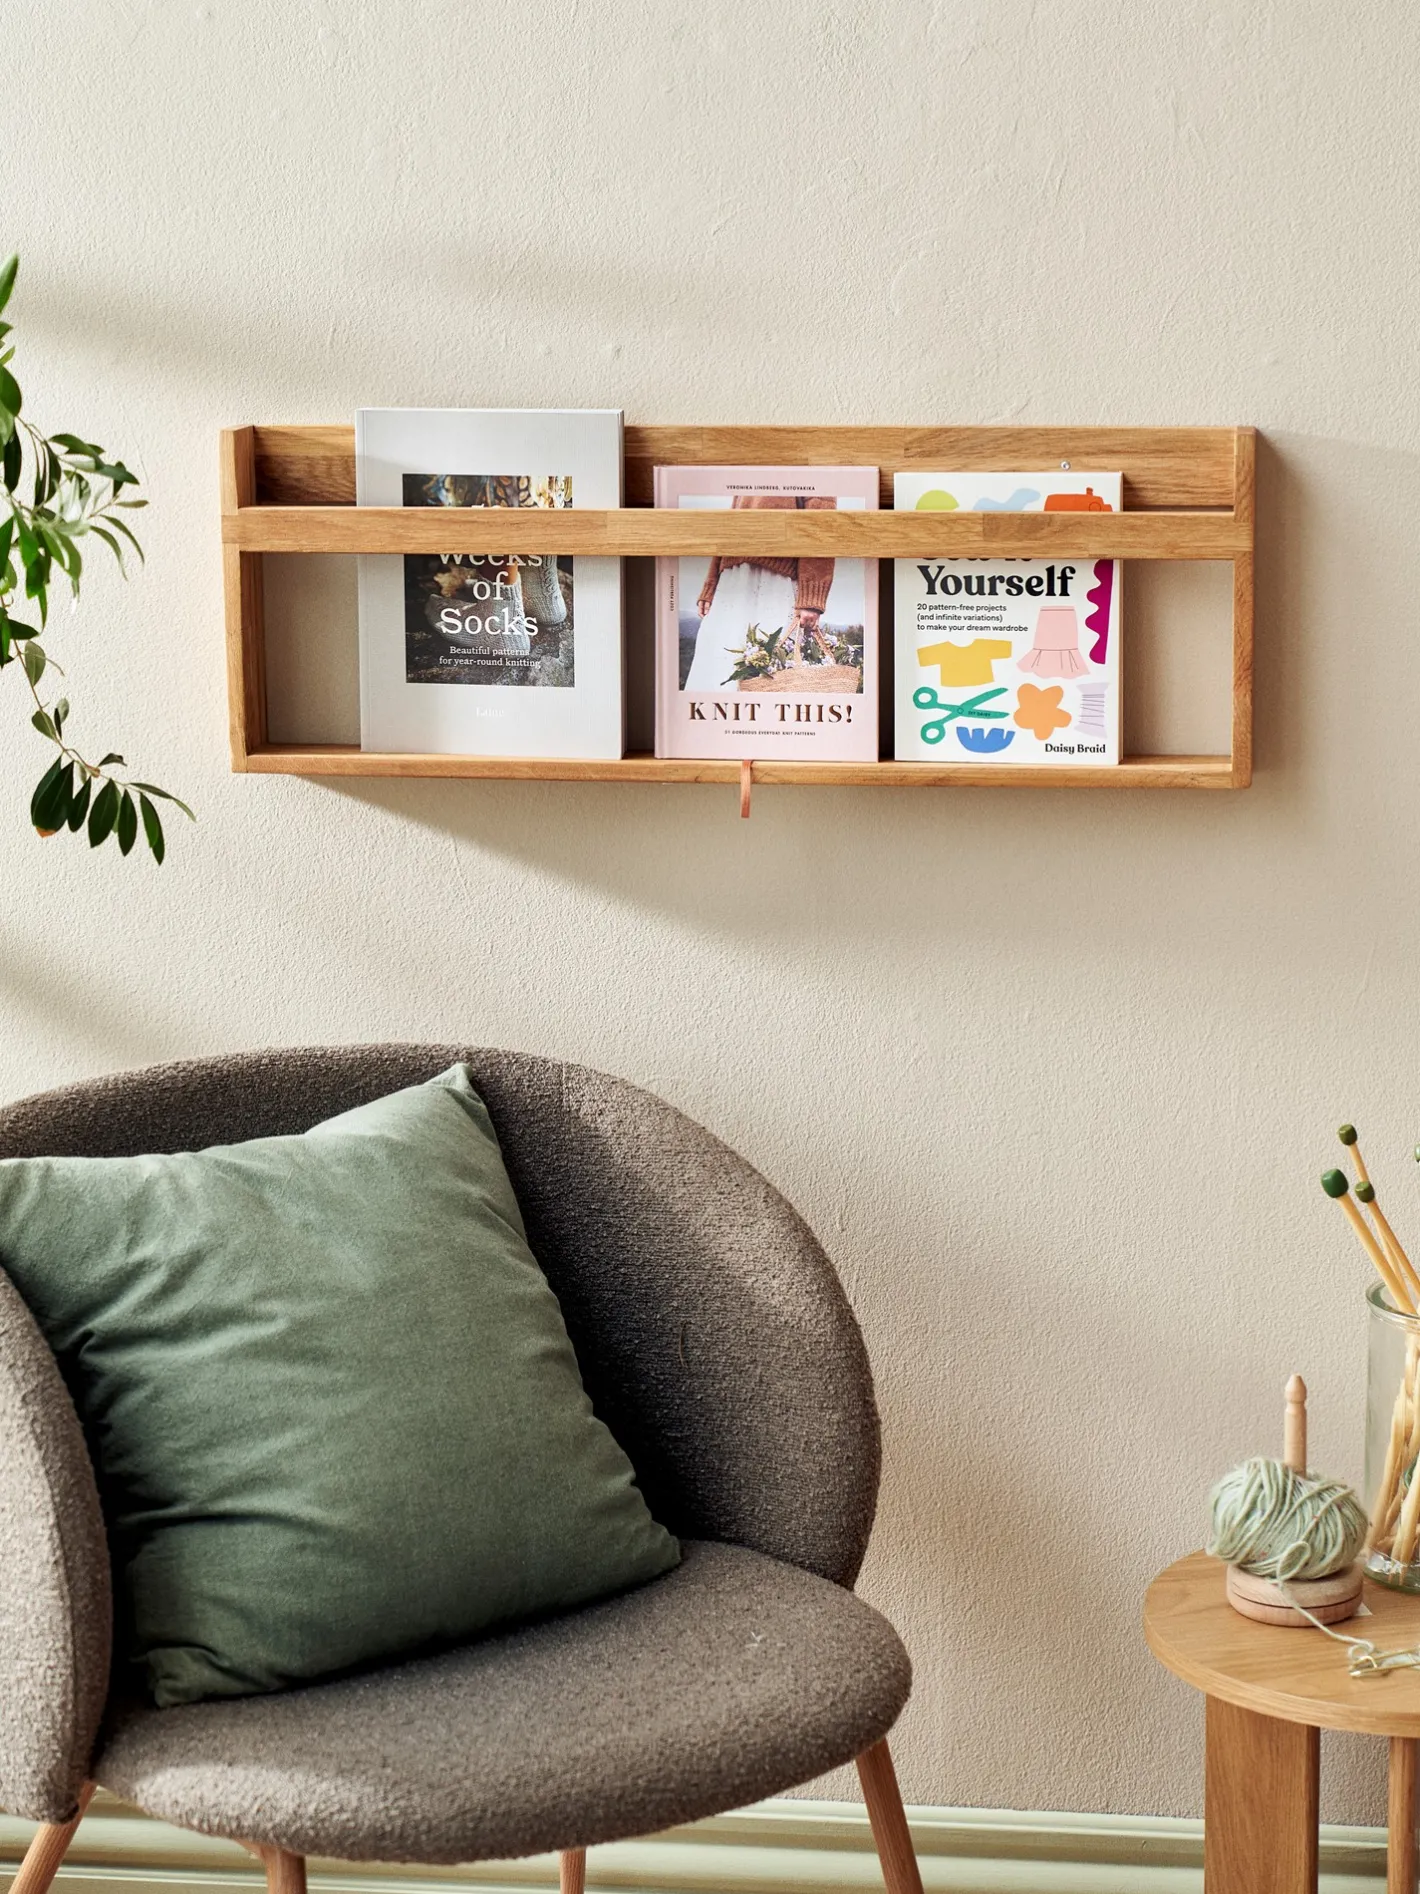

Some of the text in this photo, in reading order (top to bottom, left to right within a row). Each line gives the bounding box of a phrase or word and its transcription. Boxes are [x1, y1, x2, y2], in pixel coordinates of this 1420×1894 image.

[473, 571, 509, 600] of
[917, 565, 1076, 597] Yourself
[917, 603, 1007, 613] 20 pattern-free projects
[440, 607, 539, 636] Socks
[917, 613, 1003, 623] (and infinite variations)
[948, 625, 965, 633] your
[966, 624, 991, 632] dream
[449, 646, 530, 657] Beautiful patterns
[439, 656, 541, 669] for year-round knitting
[688, 702, 853, 724] KNIT THIS!
[1045, 743, 1106, 755] Daisy Braid
